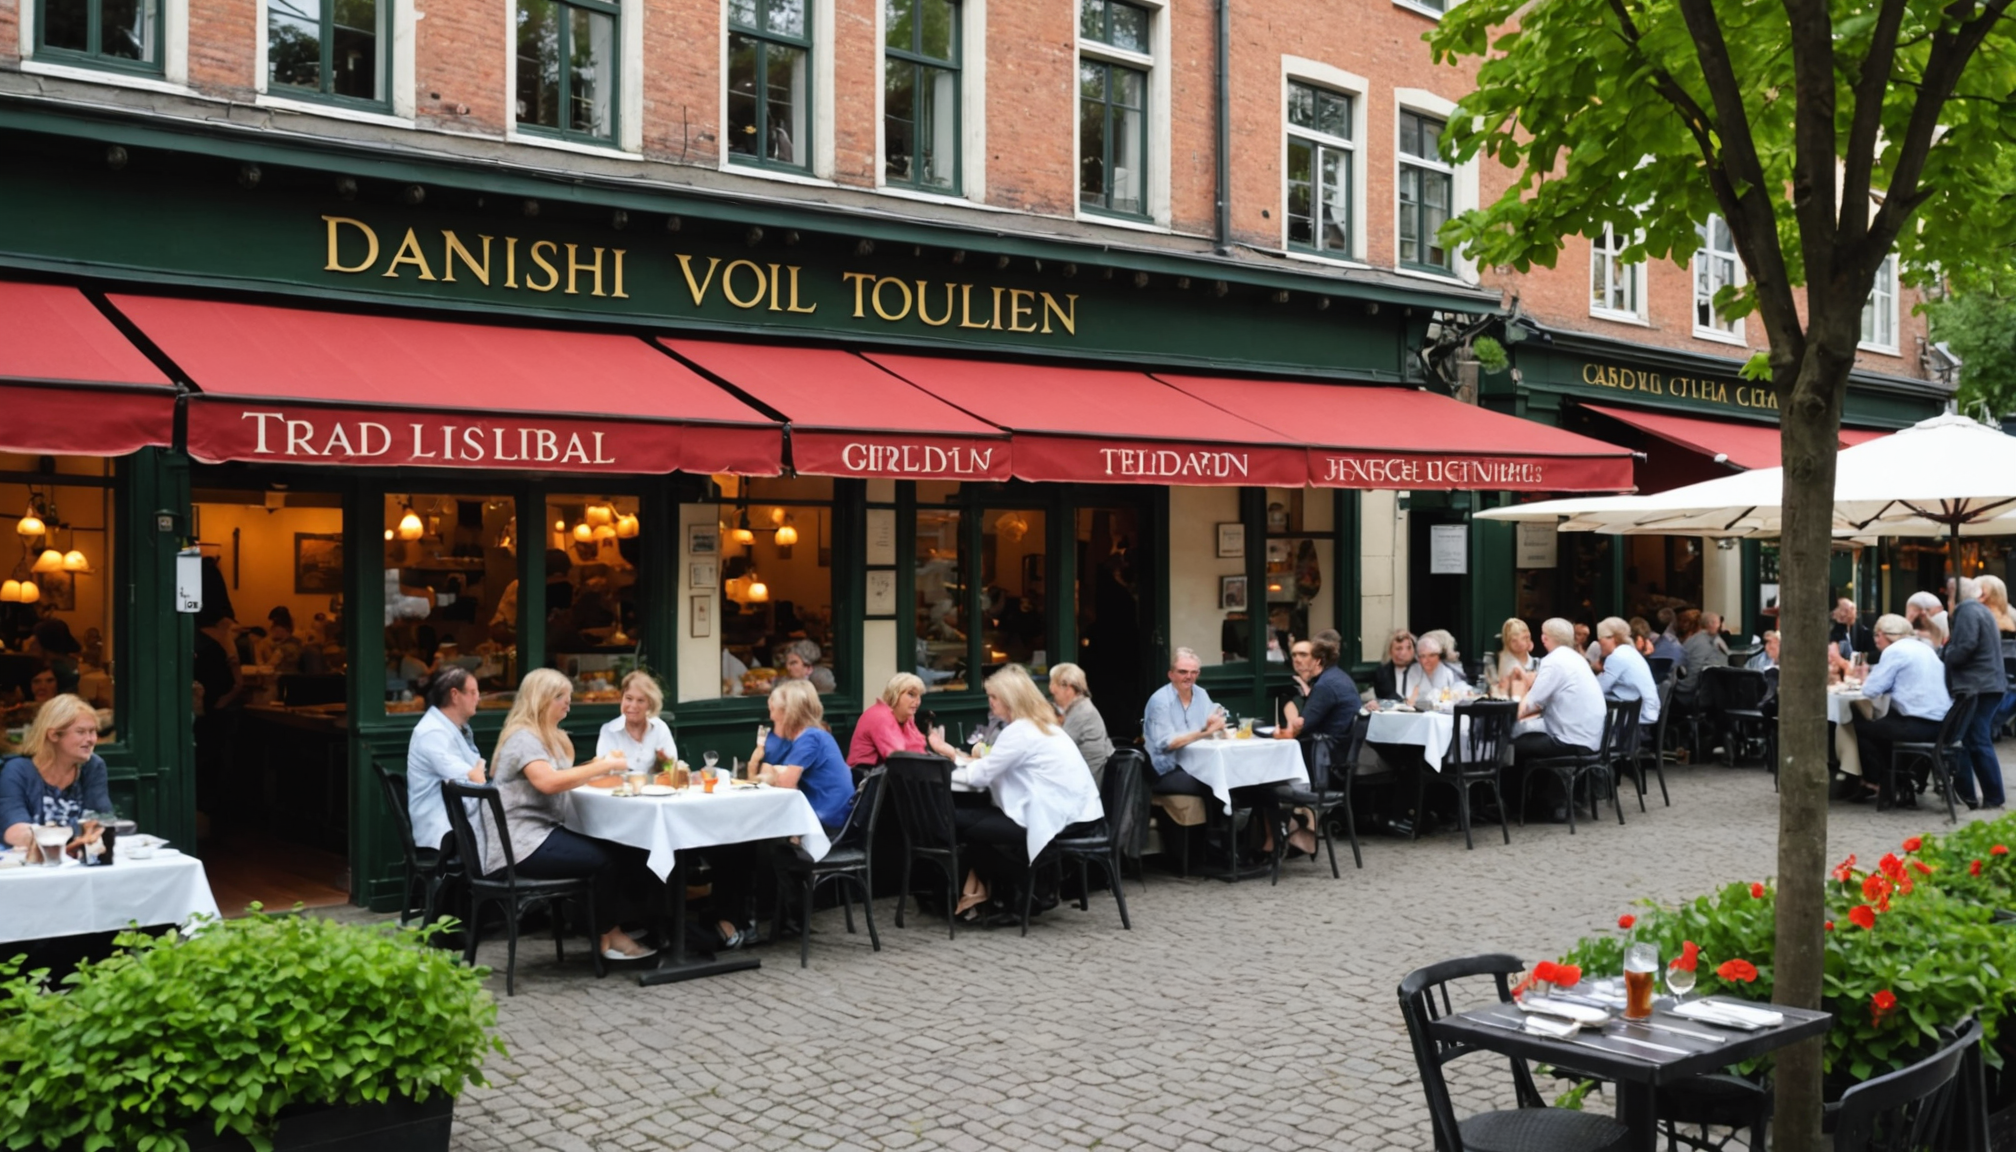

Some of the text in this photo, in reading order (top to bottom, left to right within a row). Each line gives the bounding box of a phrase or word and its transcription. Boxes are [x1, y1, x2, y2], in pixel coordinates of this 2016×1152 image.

[322, 215, 1078, 336] DANISHI VOIL TOULIEN
[242, 411, 392, 457] TRAD
